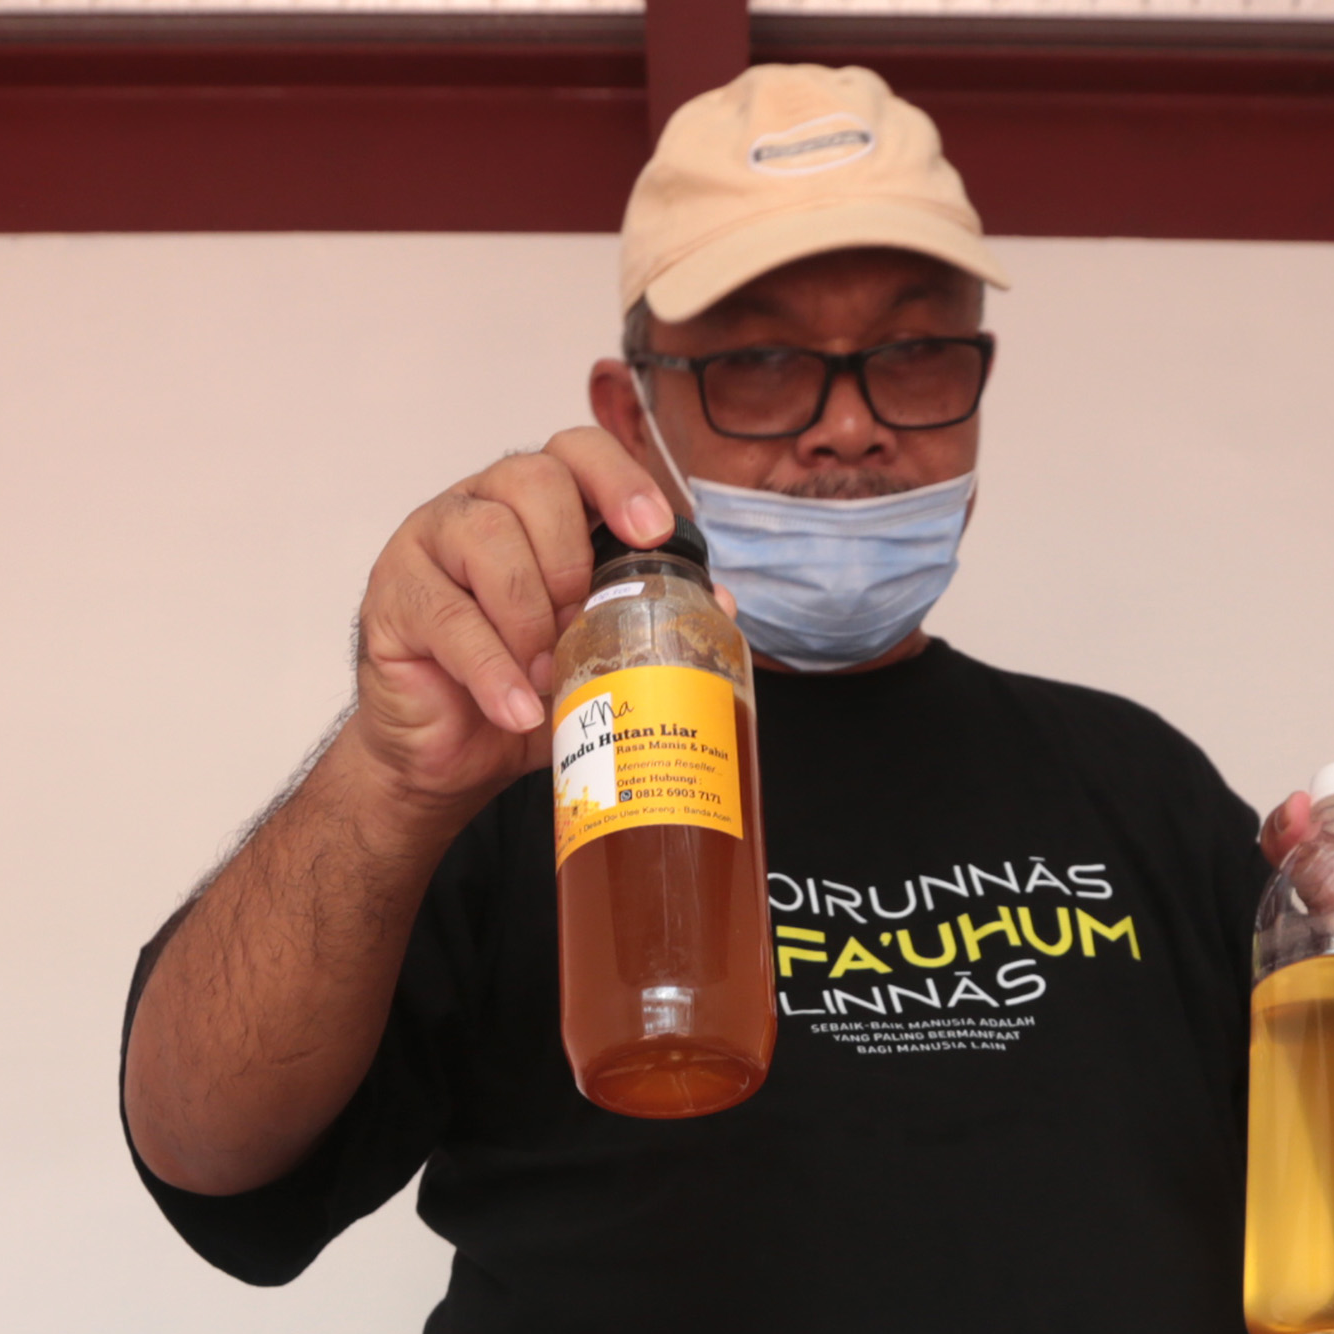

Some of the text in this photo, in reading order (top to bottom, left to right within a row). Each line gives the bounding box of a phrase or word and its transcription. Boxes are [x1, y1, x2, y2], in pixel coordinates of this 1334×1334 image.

[559, 723, 698, 774] Madu Hutan Liar
[616, 740, 729, 761] Rasa Manis & Pahit
[617, 760, 671, 773] Menerima
[616, 776, 646, 788] Order
[650, 774, 698, 785] Hubungi
[635, 787, 722, 804] 0812 6903 7171
[642, 805, 676, 814] Kareng
[684, 806, 711, 817] Banda
[778, 959, 1047, 1016] LINNĀS
[811, 1015, 1036, 1034] SEBAIK-BAIK MANUSIA ADALAH
[832, 1029, 1021, 1043] YANG PALING BERMANFAAT
[857, 1040, 1007, 1055] BAGI MANUSIA LAIN
